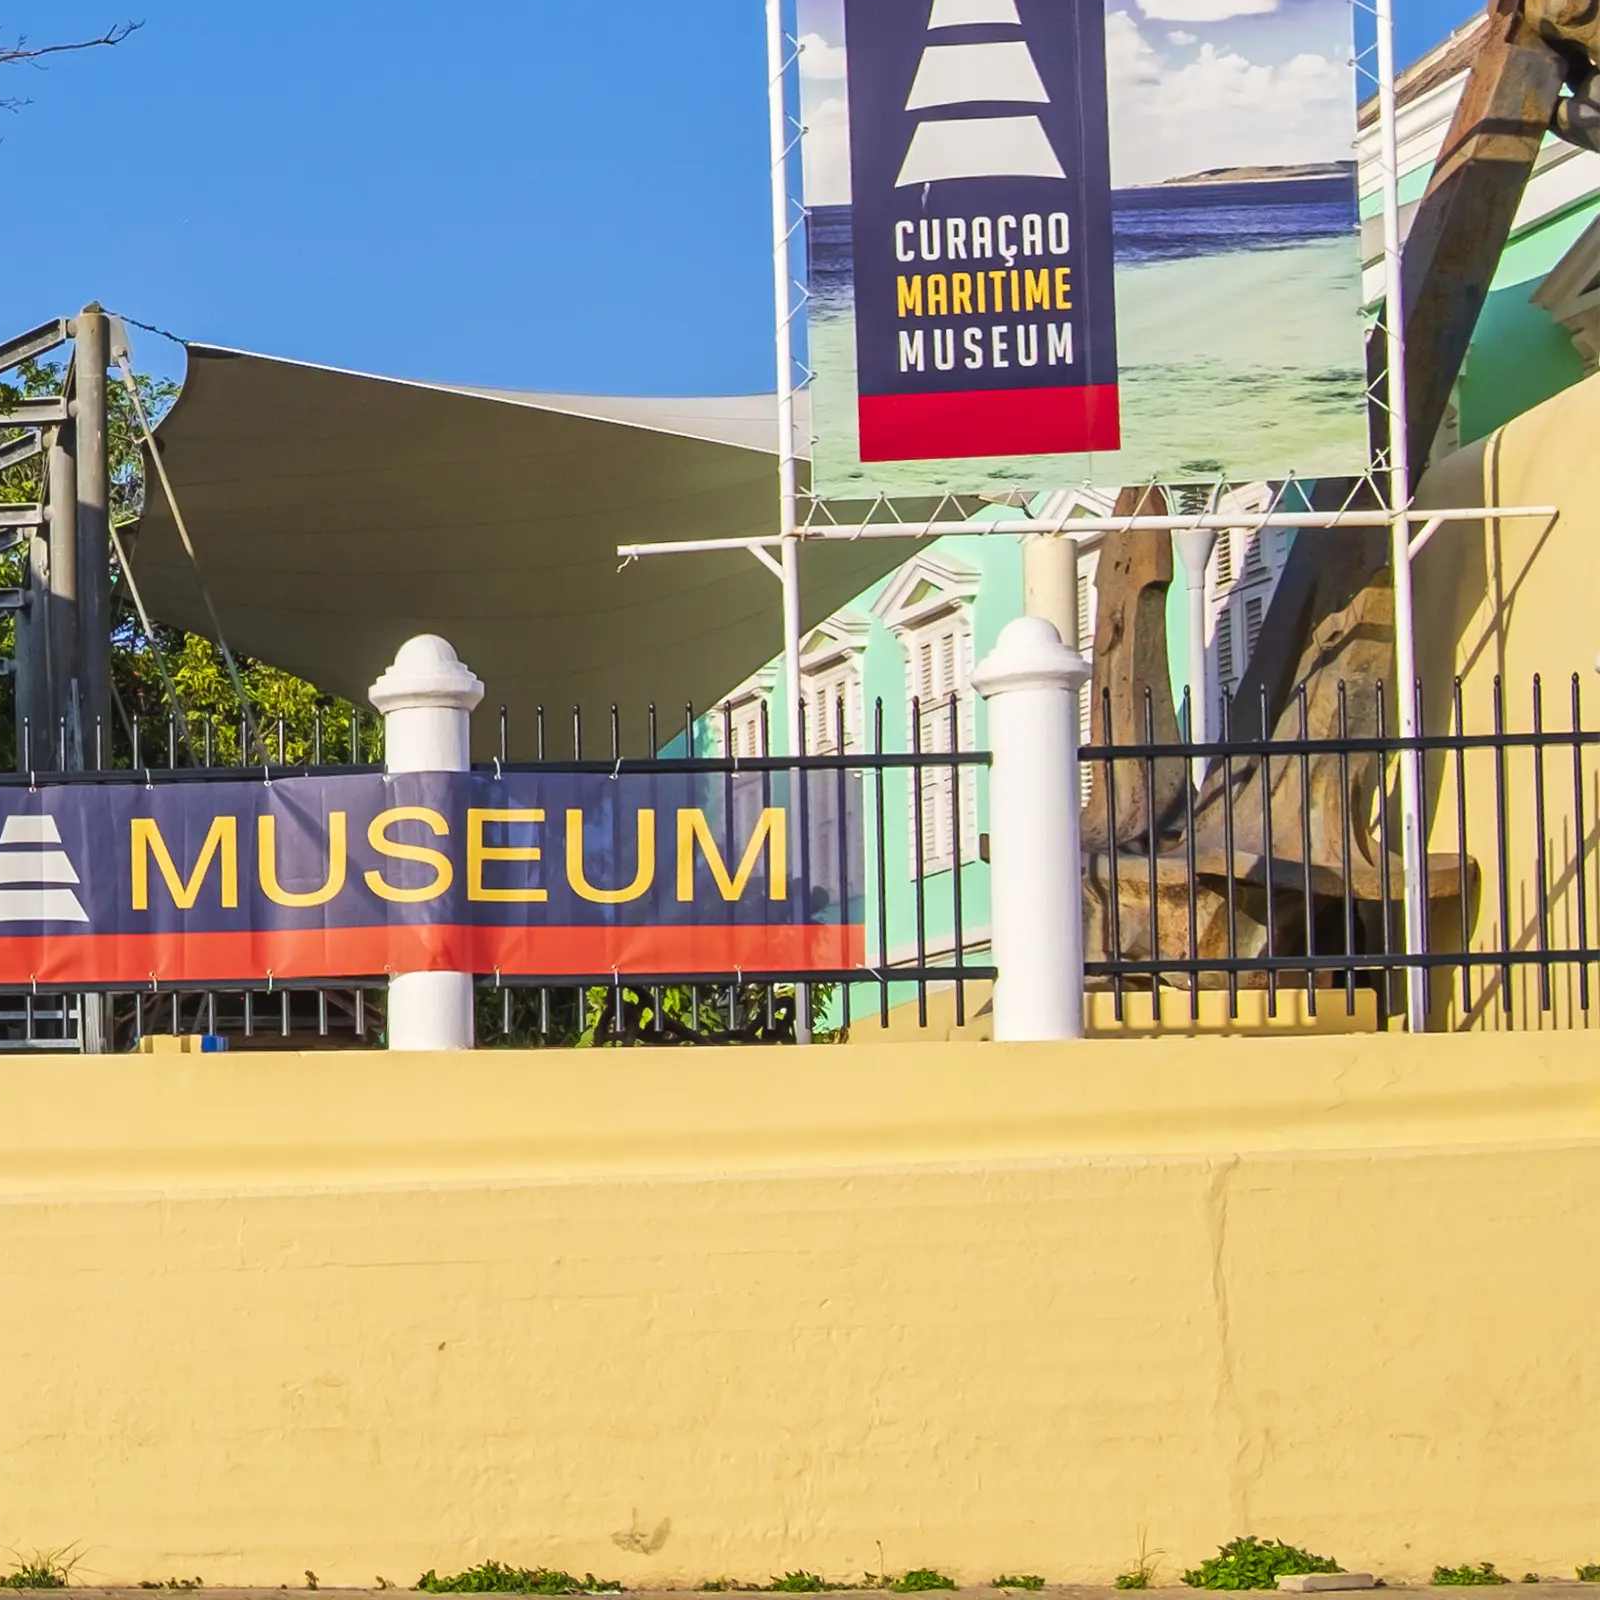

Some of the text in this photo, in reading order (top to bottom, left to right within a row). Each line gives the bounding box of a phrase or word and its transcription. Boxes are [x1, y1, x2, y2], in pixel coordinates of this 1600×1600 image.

[895, 212, 1070, 267] CURAÇAO
[896, 267, 1072, 317] MARITIME
[898, 322, 1074, 373] MUSEUM
[130, 807, 788, 911] MUSEUM
